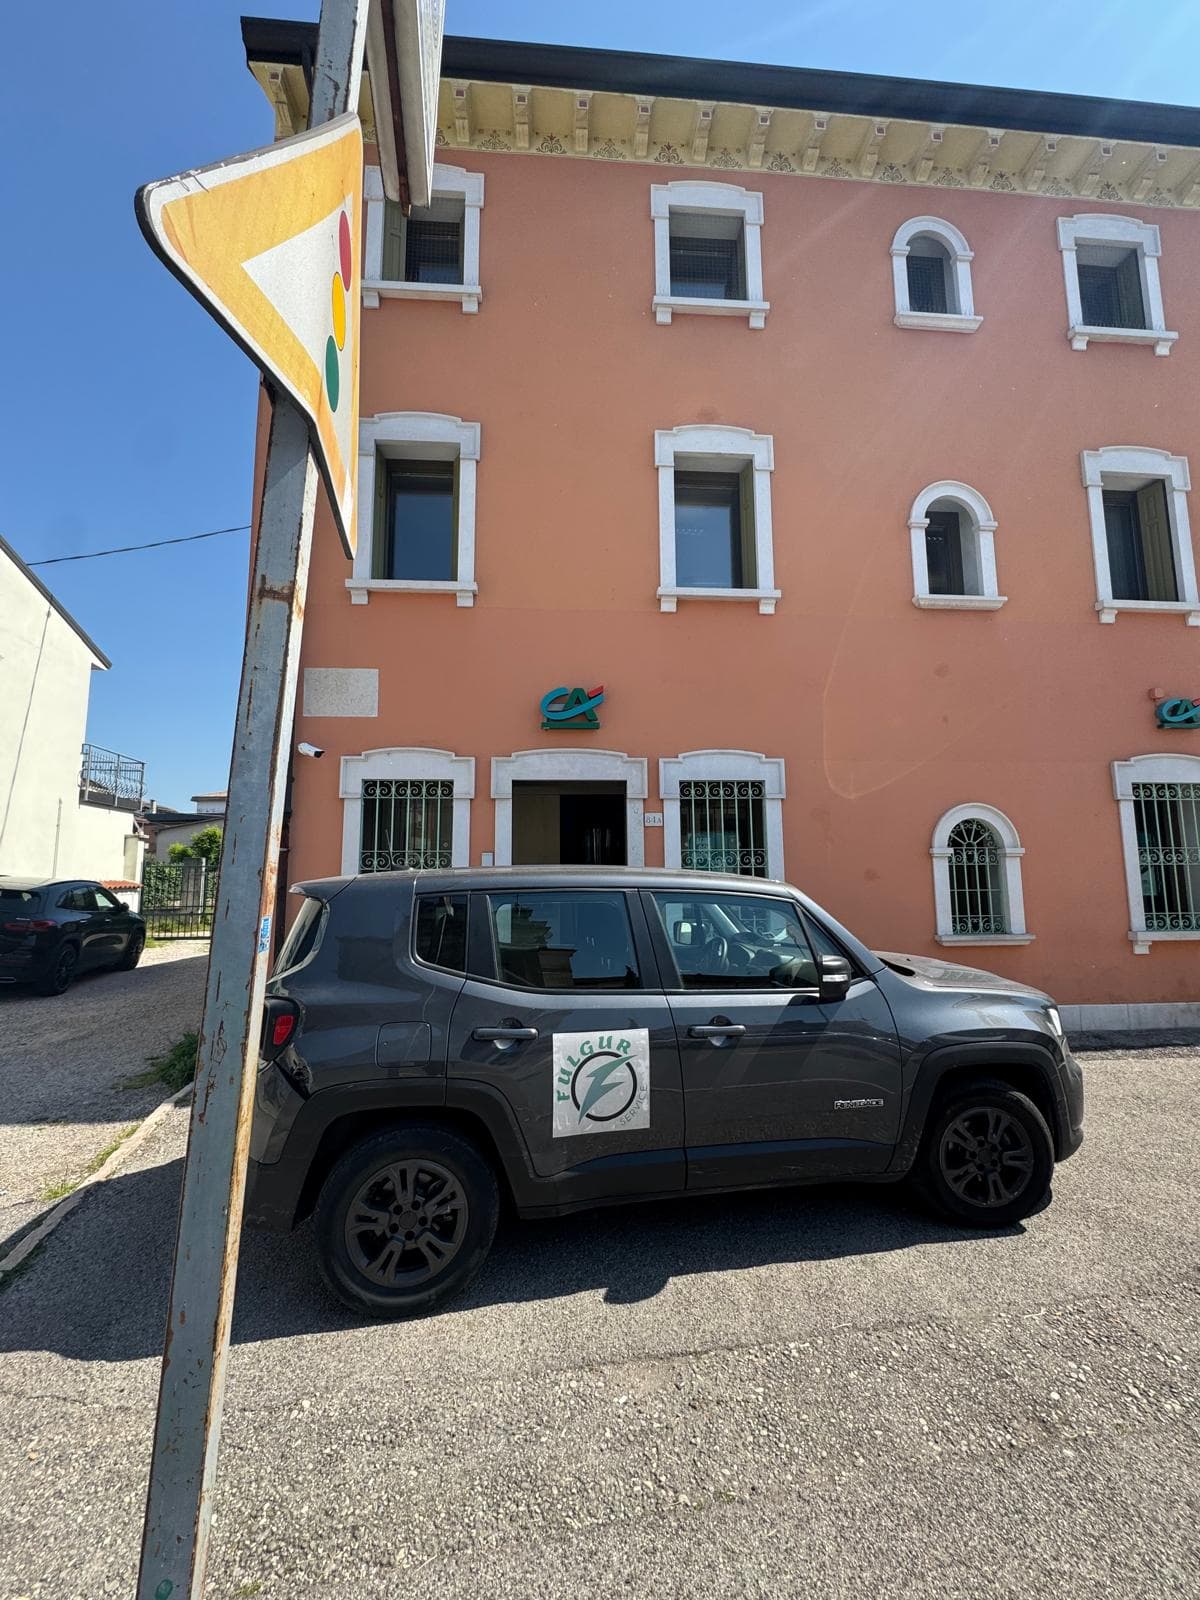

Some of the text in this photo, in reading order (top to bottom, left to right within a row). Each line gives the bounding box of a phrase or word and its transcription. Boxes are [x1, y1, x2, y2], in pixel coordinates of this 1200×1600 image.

[556, 1035, 631, 1104] FULGUR
[619, 1084, 648, 1126] SERVICE
[834, 1098, 884, 1110] RENEGADE
